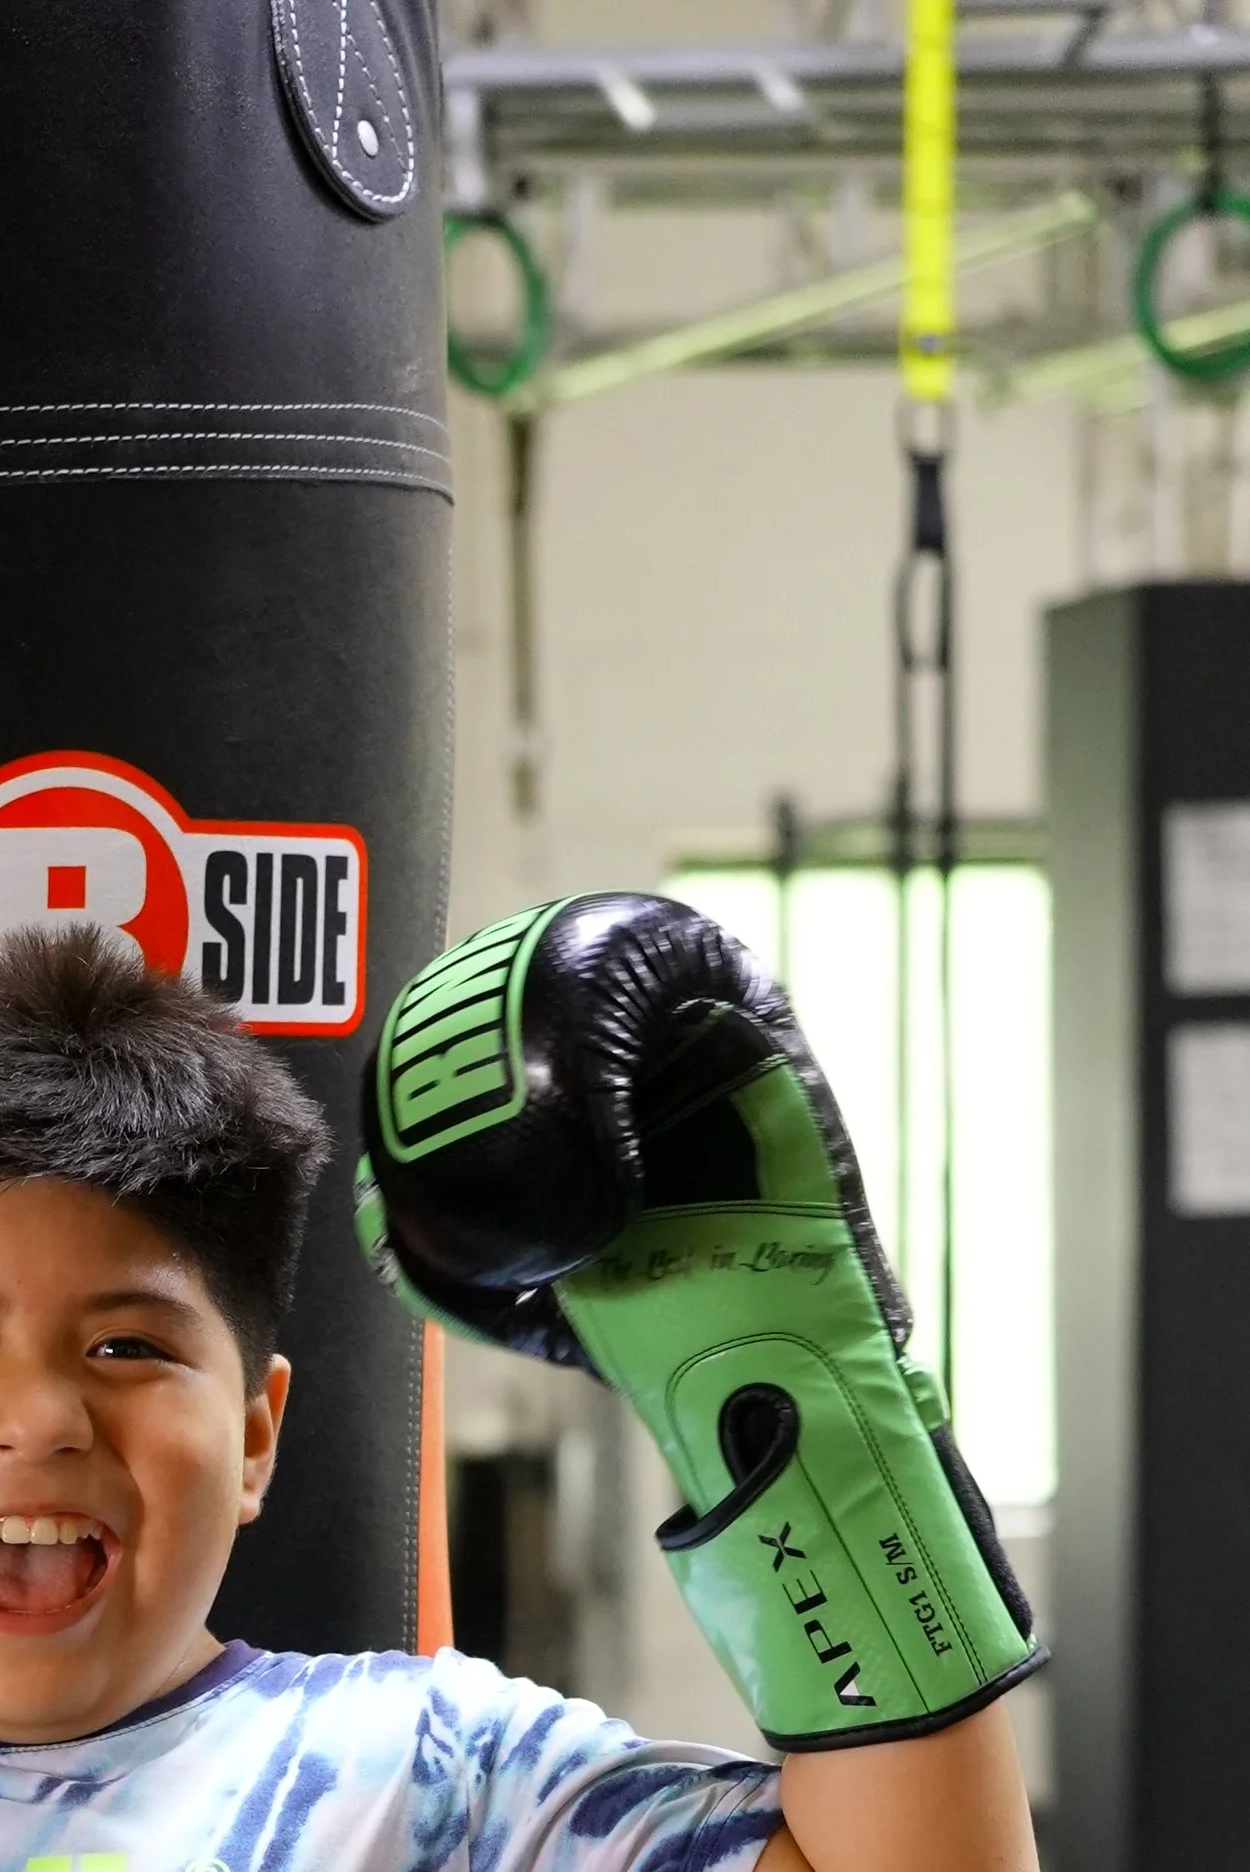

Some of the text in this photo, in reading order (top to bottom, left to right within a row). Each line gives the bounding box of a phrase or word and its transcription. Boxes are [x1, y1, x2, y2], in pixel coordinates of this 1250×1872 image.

[202, 850, 348, 1006] SIDE
[757, 1521, 877, 1707] APEX
[878, 1532, 953, 1658] FTG1 S/M
